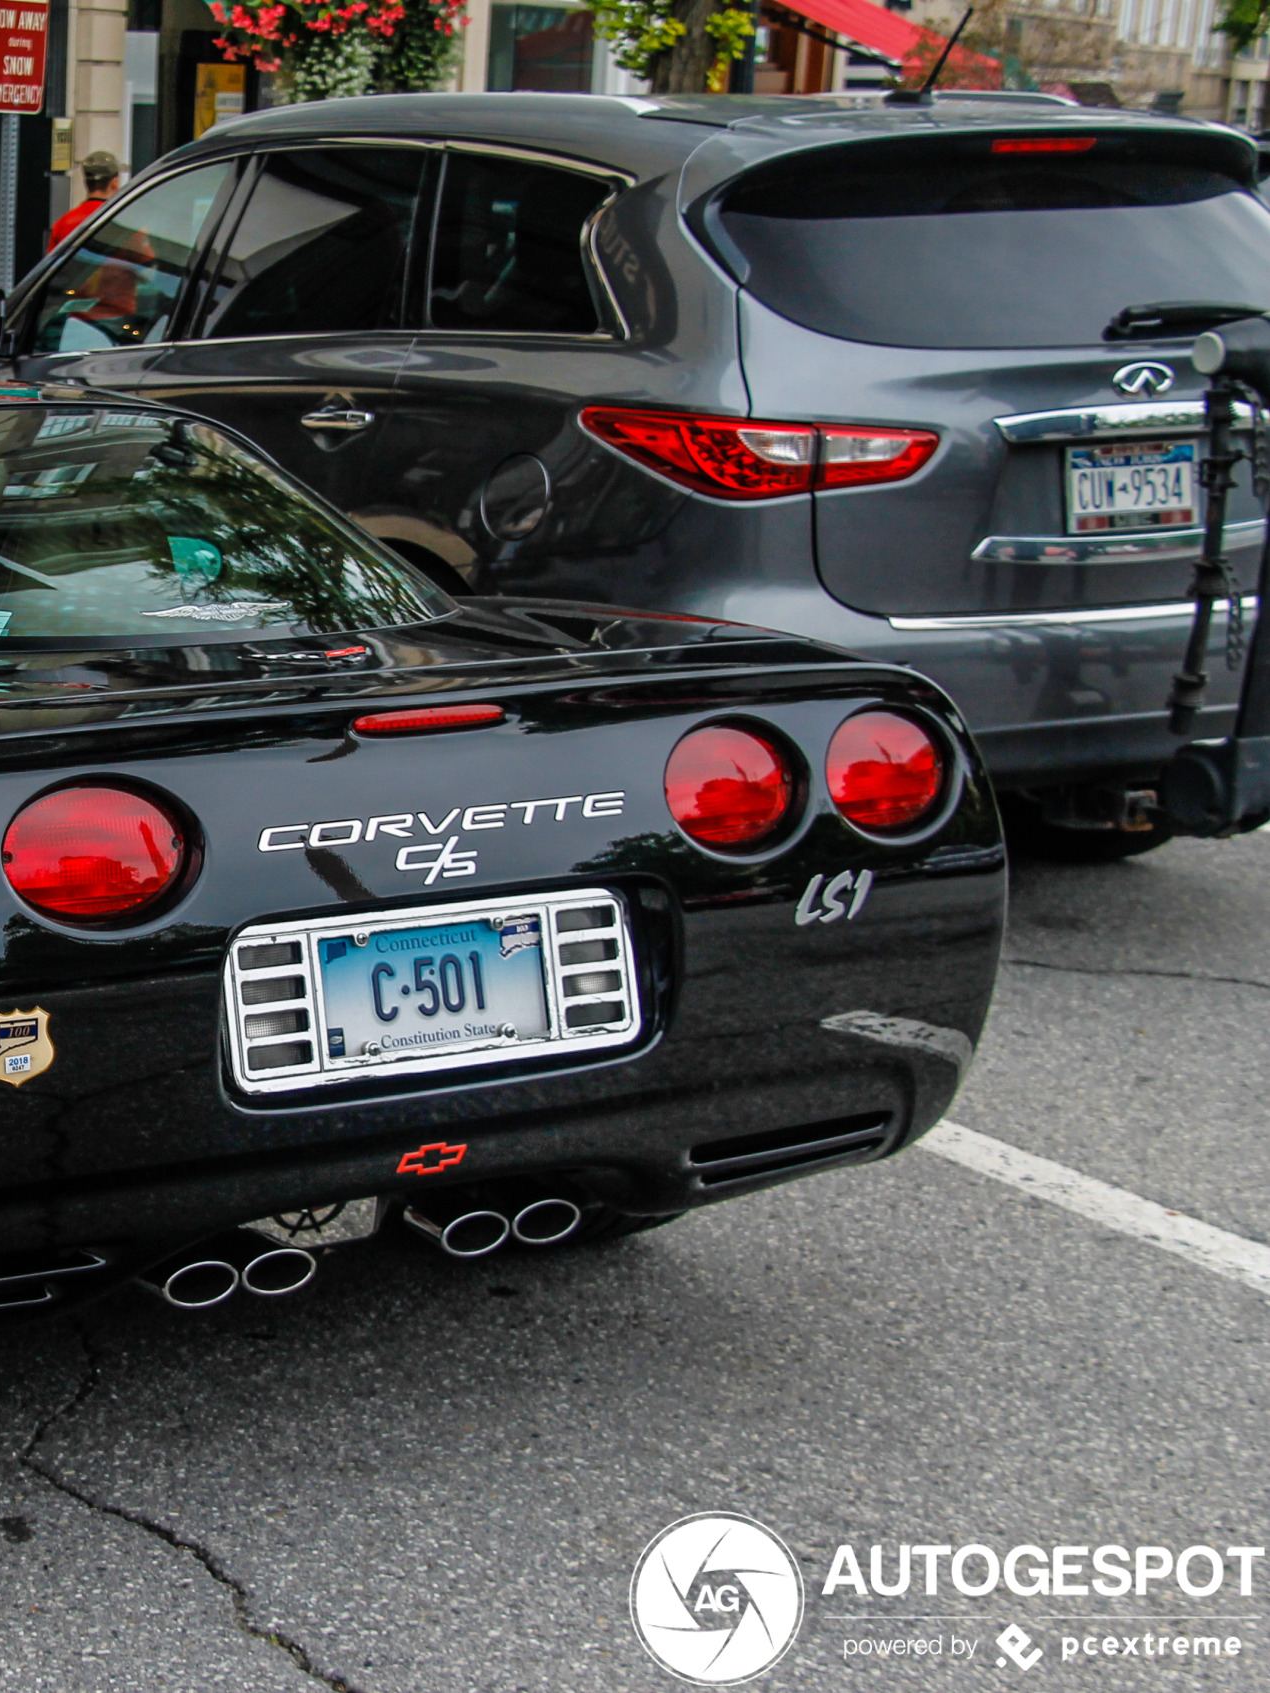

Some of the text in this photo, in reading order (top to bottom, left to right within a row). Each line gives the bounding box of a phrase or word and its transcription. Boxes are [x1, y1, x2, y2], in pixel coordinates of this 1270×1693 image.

[18, 11, 48, 31] AWAY
[8, 37, 33, 51] during
[3, 56, 34, 76] SNOW
[258, 790, 626, 853] CORVETTE
[375, 928, 477, 953] Connecticut
[8, 1025, 31, 1038] 100
[380, 1024, 497, 1049] Constitution State
[8, 1056, 29, 1067] 2018
